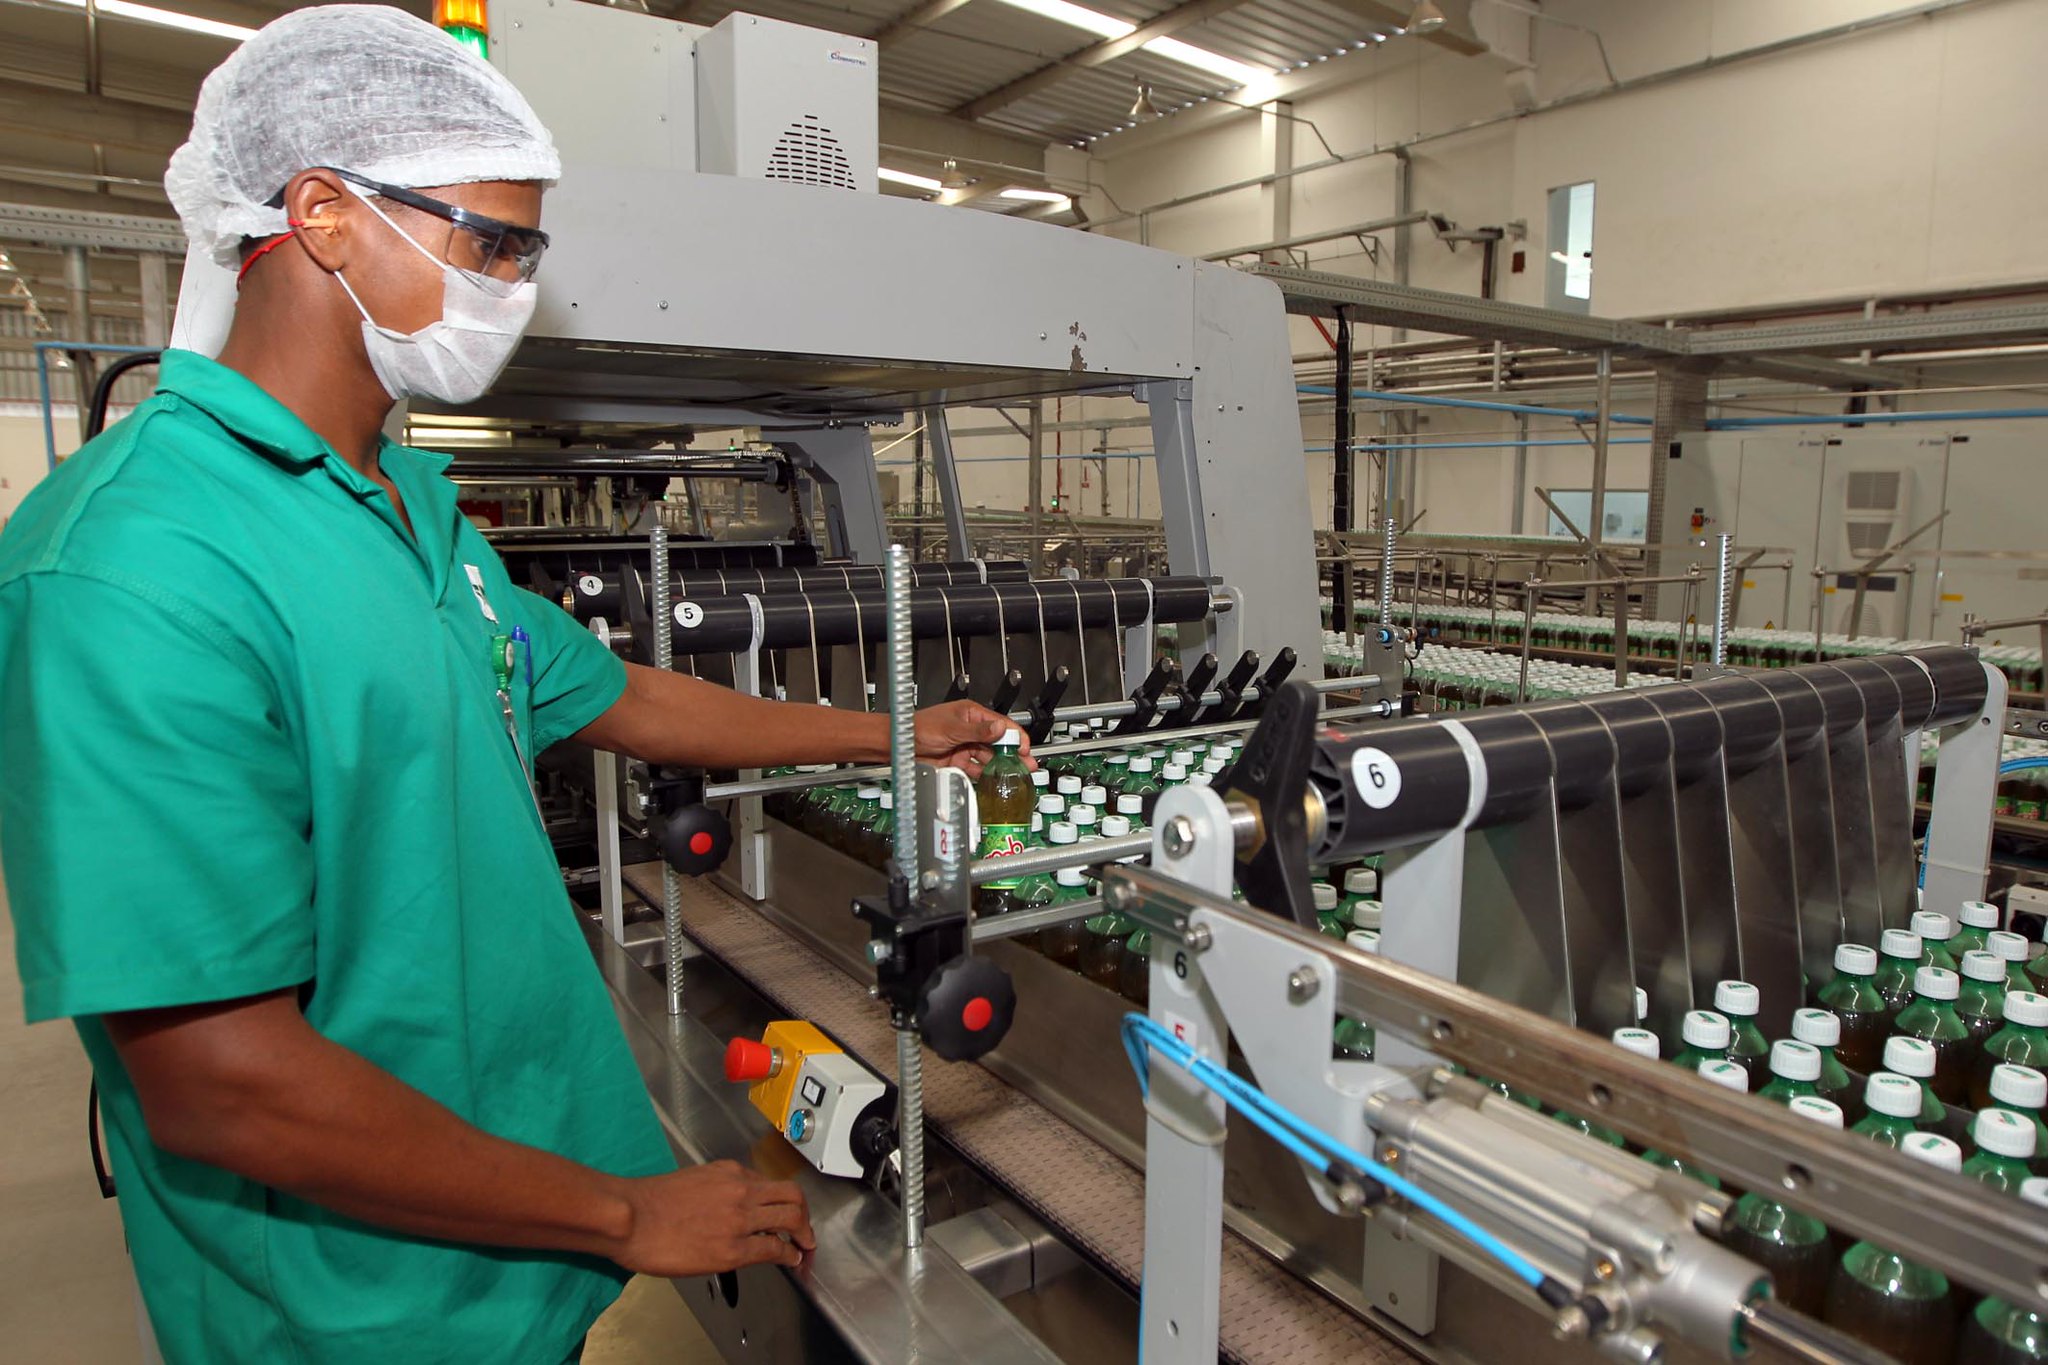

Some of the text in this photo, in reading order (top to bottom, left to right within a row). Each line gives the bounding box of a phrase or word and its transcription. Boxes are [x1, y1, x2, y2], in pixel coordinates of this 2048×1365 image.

[587, 579, 595, 589] 4
[684, 607, 694, 620] 5
[1368, 763, 1385, 789] 6
[1174, 951, 1187, 979] 6
